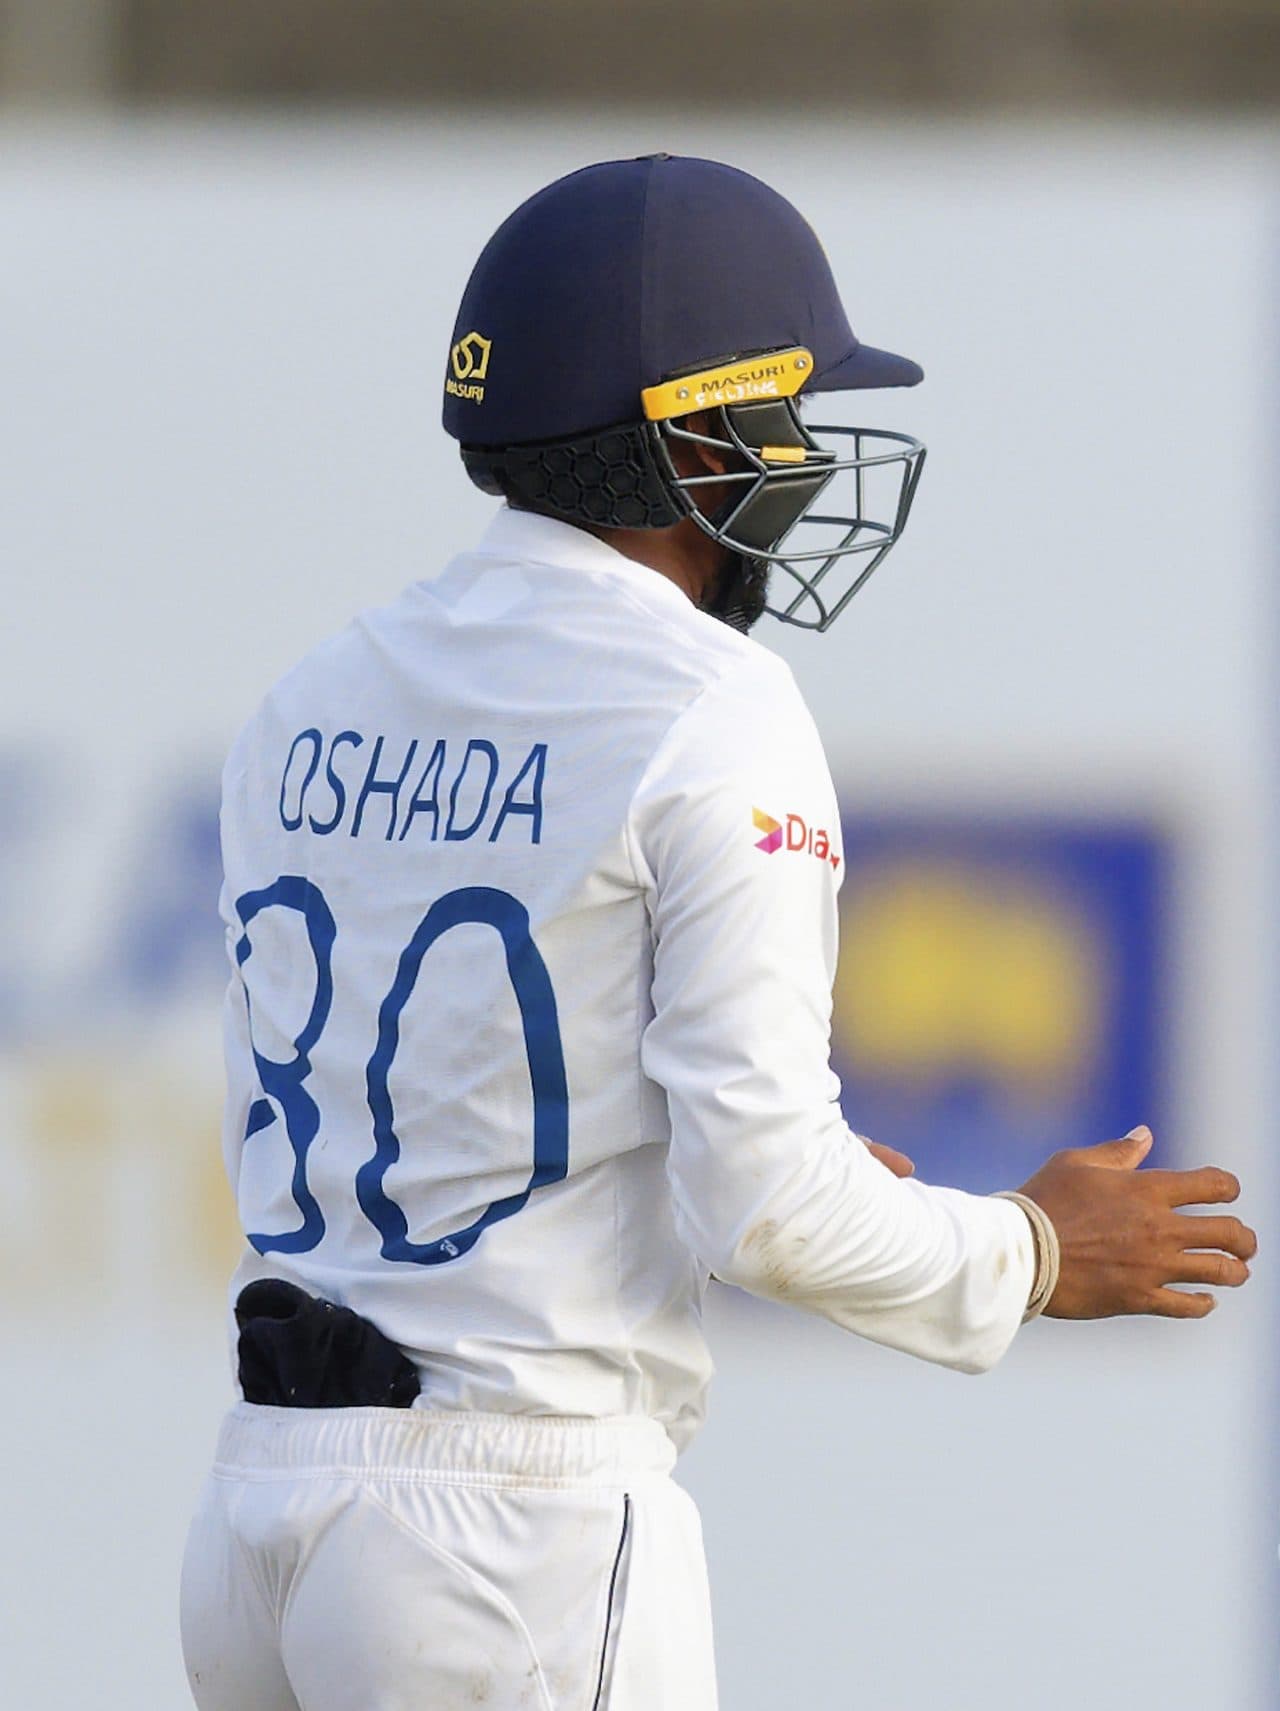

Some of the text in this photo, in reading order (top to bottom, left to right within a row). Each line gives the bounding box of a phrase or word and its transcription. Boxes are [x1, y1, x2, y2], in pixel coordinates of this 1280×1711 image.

[701, 364, 785, 393] MASURI
[279, 727, 549, 845] OSHADA
[235, 874, 570, 1266] 80
